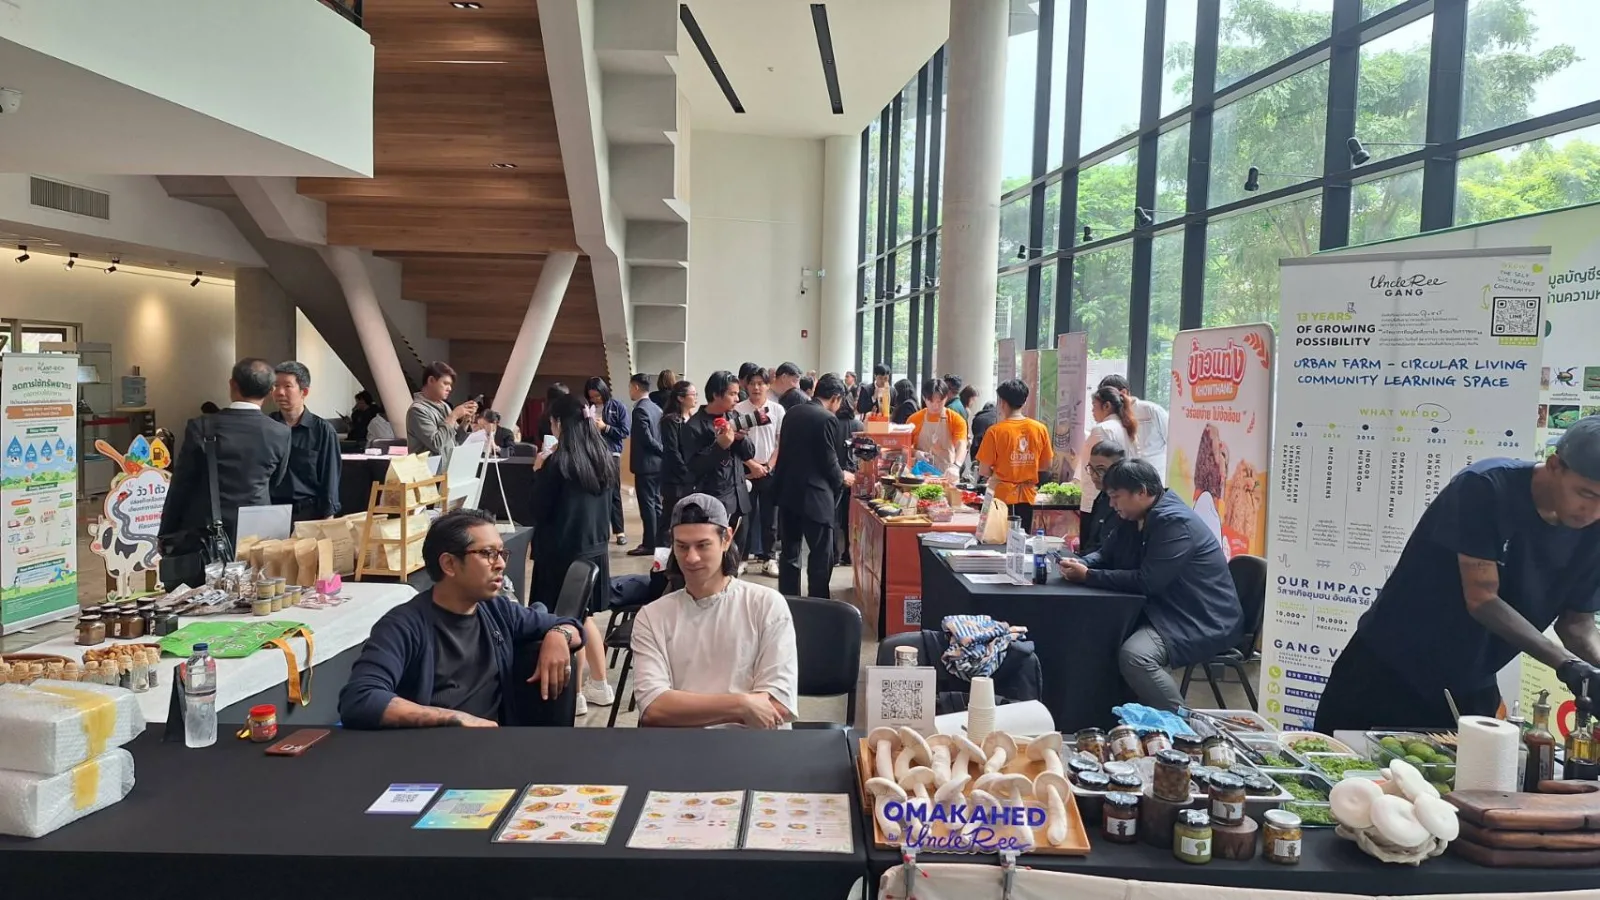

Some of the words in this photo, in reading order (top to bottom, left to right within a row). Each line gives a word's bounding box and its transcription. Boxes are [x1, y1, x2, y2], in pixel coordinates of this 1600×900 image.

[1385, 289, 1424, 297] GANG
[1296, 313, 1308, 321] 13
[1311, 312, 1352, 321] YEARS
[1297, 325, 1312, 334] OF
[1315, 324, 1376, 334] GROWING
[1296, 337, 1371, 346] POSSIBILITY
[1188, 338, 1246, 383] ข้าวแท่ง
[1293, 358, 1337, 369] URBAN
[1343, 358, 1381, 370] FARM
[1401, 358, 1468, 371] CIRCULAR
[1474, 359, 1528, 371] LIVING
[1297, 374, 1379, 386] COMMUNITY
[1384, 375, 1457, 387] LEARNING
[1463, 376, 1510, 388] SPACE
[1360, 408, 1394, 416] WHAT
[1400, 409, 1417, 417] WE
[1422, 410, 1439, 418] DO
[1325, 446, 1334, 499] MICROGREENS
[1356, 449, 1364, 492] MUSHROOM
[1389, 452, 1397, 494] SIGNATURE
[1397, 452, 1405, 495] OMAKAHED
[1277, 575, 1309, 588] OUR
[1317, 580, 1382, 597] IMPACT
[1277, 586, 1330, 601] วิสาหกิจชุมชน
[1274, 639, 1320, 654] GANG
[884, 801, 1046, 827] OMAKAHED
